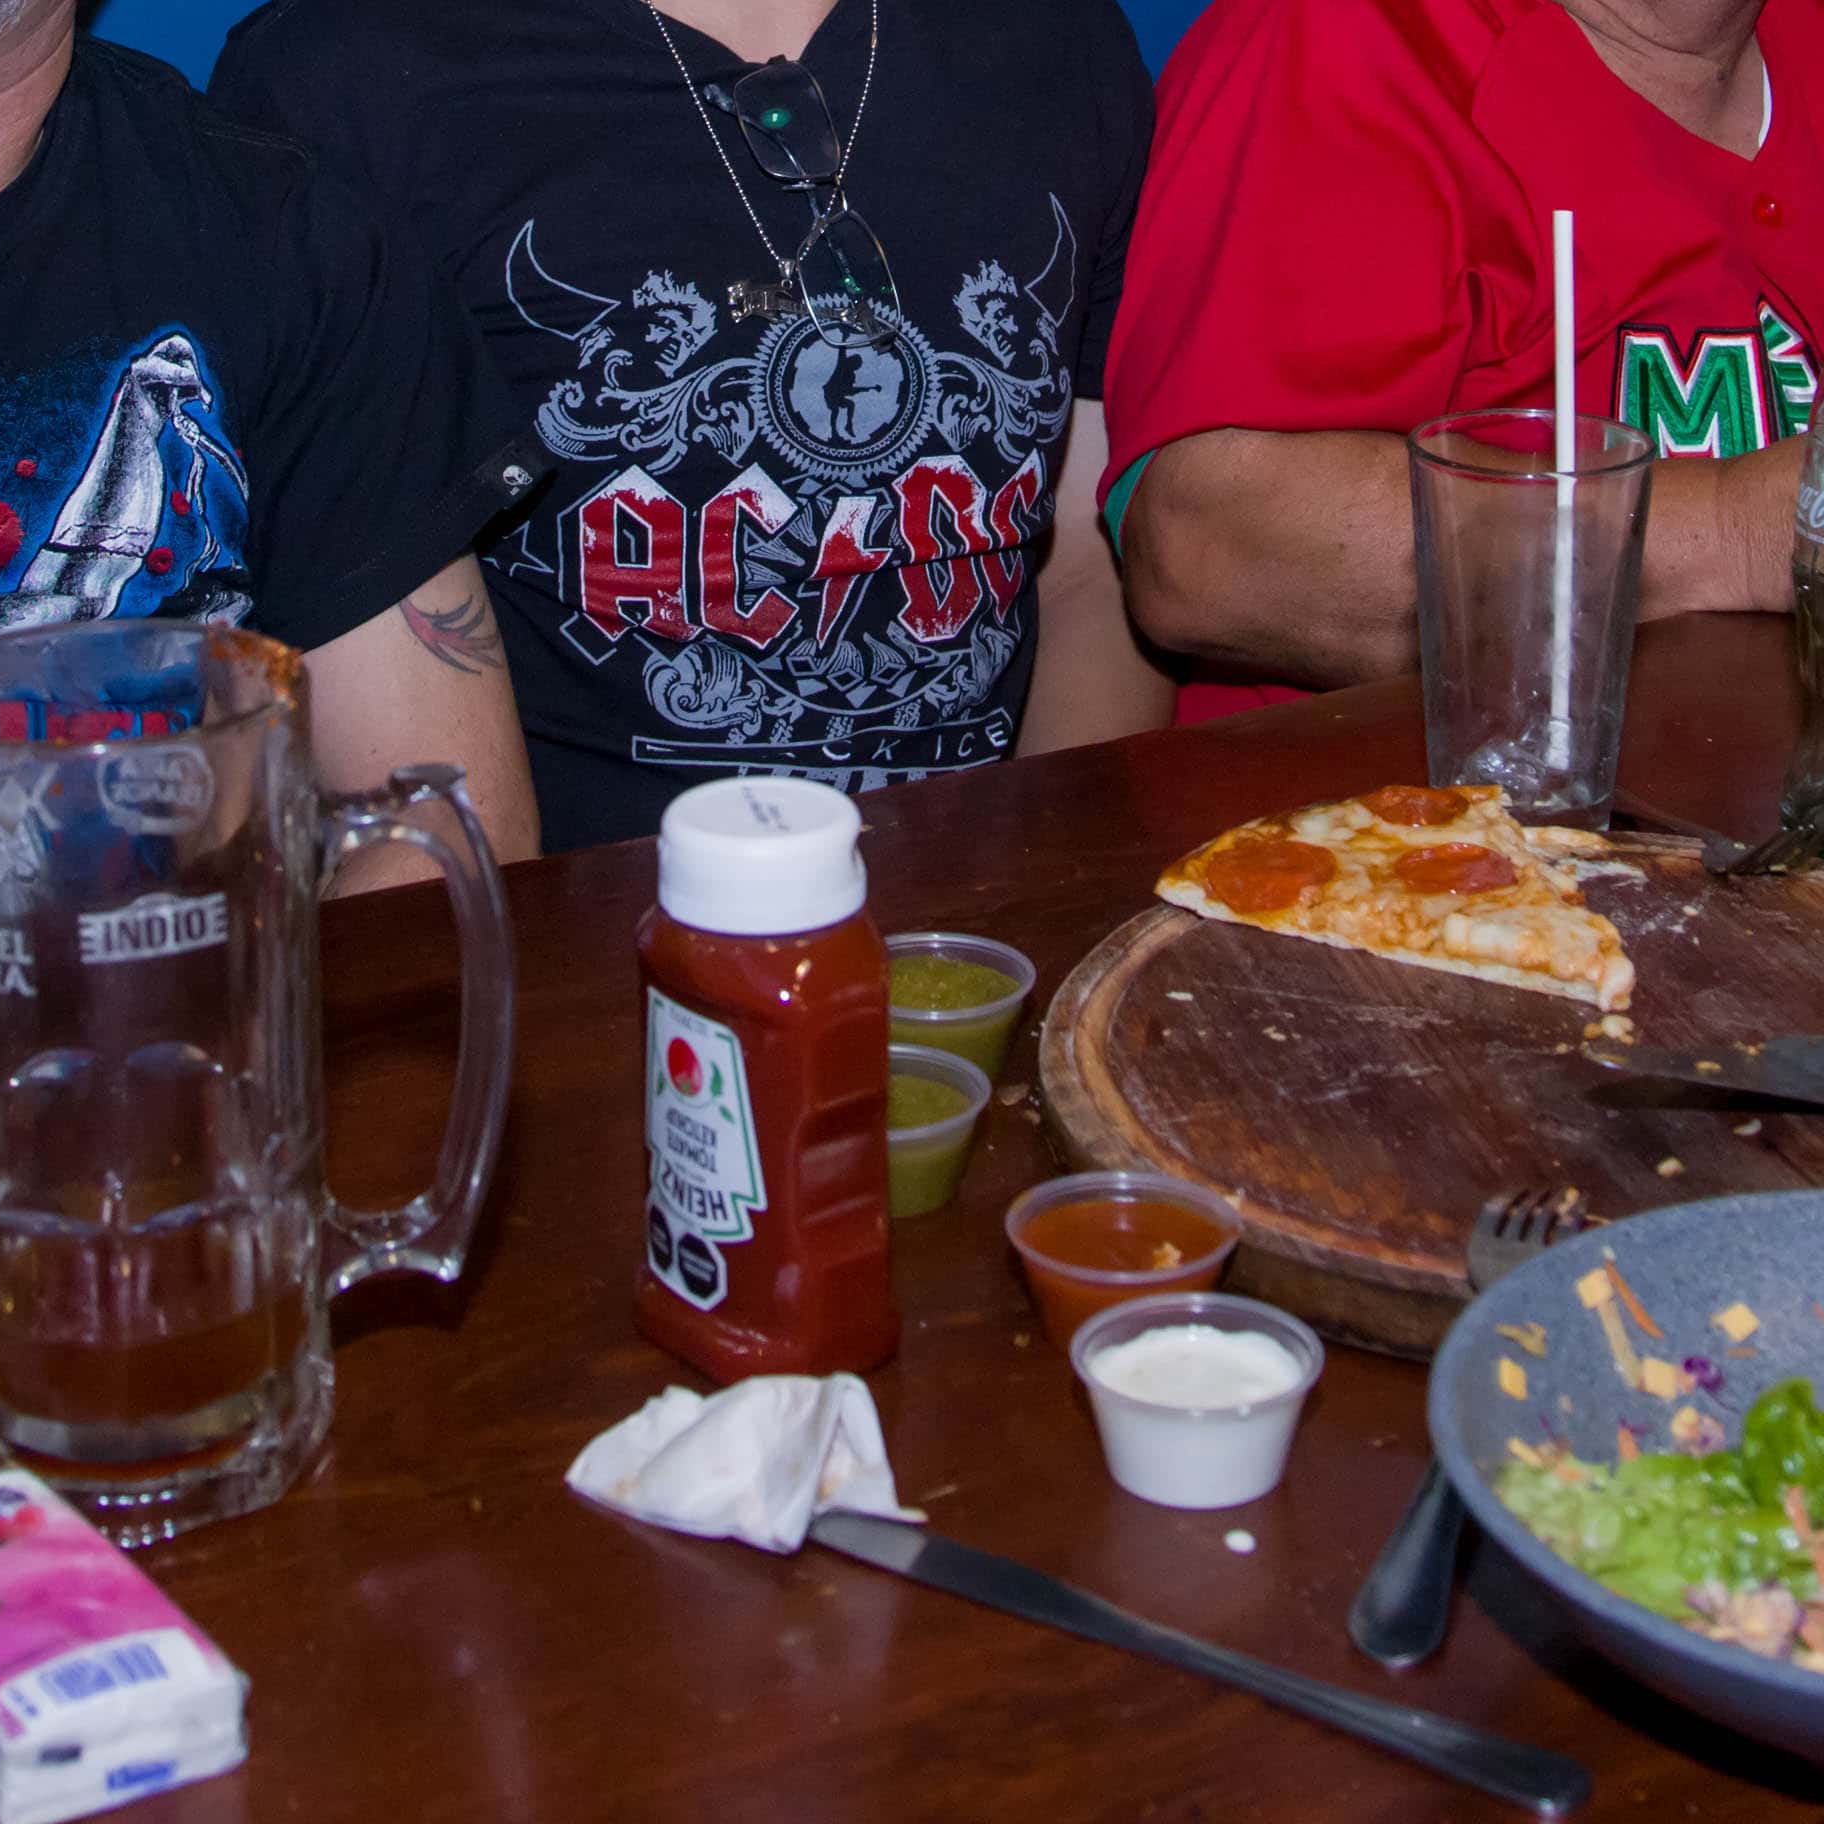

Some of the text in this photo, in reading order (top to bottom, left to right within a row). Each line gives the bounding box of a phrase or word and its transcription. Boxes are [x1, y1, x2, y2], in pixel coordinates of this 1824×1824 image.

[926, 720, 1010, 762] ICE
[102, 906, 207, 953] INDIO
[667, 1126, 718, 1176] TOMATE
[661, 1160, 729, 1222] HEINZ
